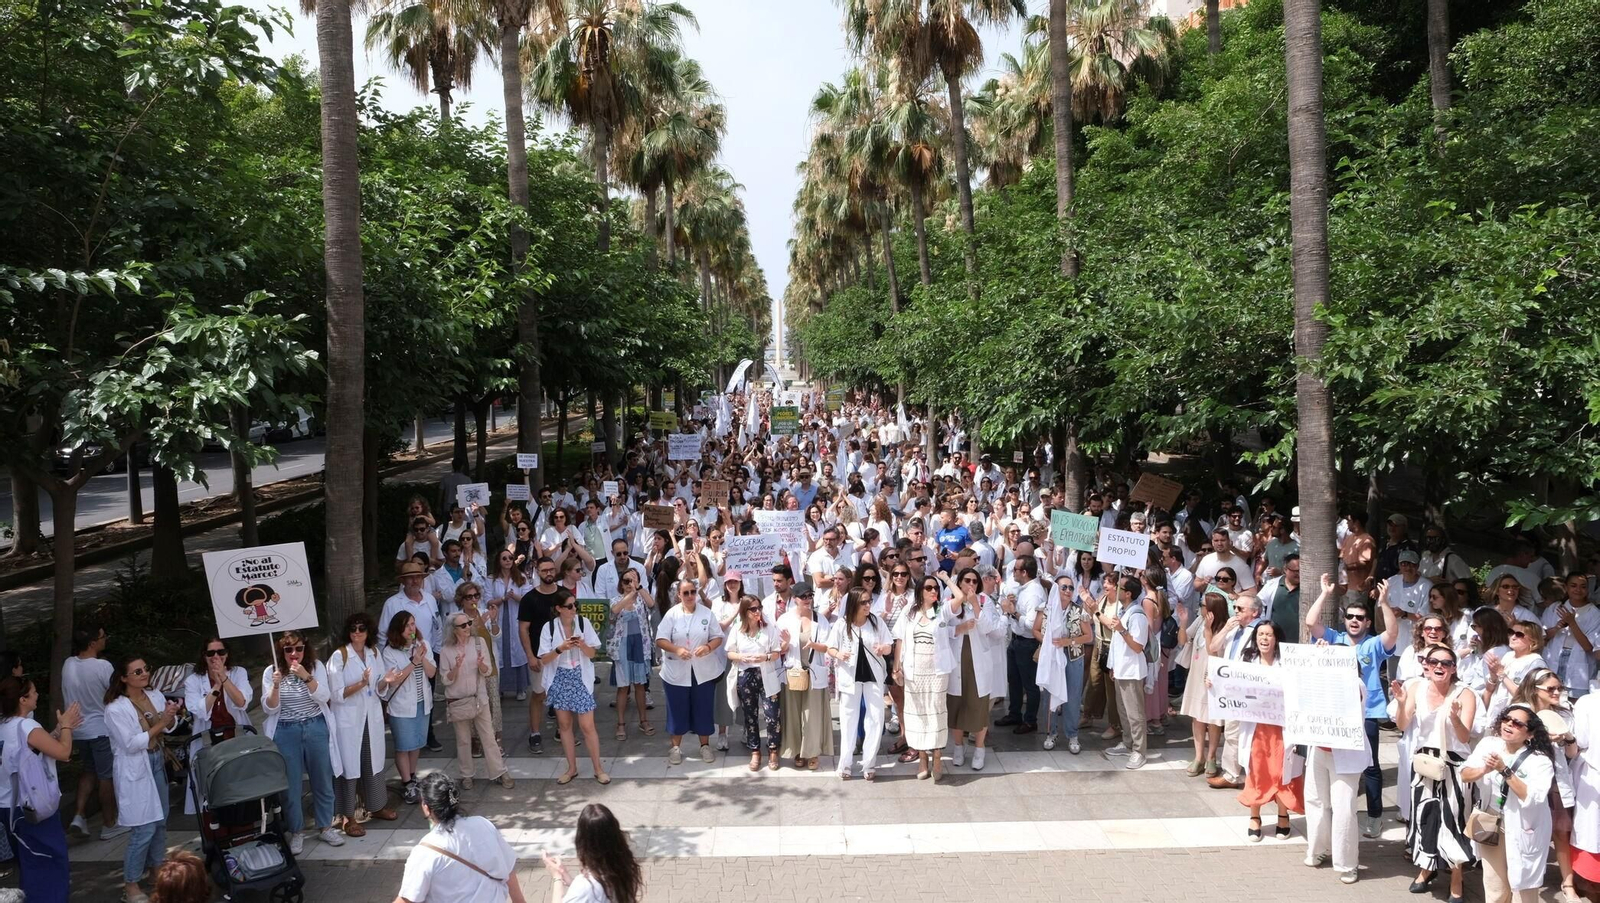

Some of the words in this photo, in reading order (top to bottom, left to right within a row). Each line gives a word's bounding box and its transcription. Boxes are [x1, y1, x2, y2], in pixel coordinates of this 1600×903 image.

[1108, 534, 1145, 546] ESTATUTO
[1107, 546, 1136, 556] PROPIO
[235, 564, 280, 573] Estatuto
[242, 571, 277, 580] Marco!
[581, 604, 604, 612] ESTE
[1218, 696, 1248, 709] SALUD
[1310, 726, 1325, 736] NOS
